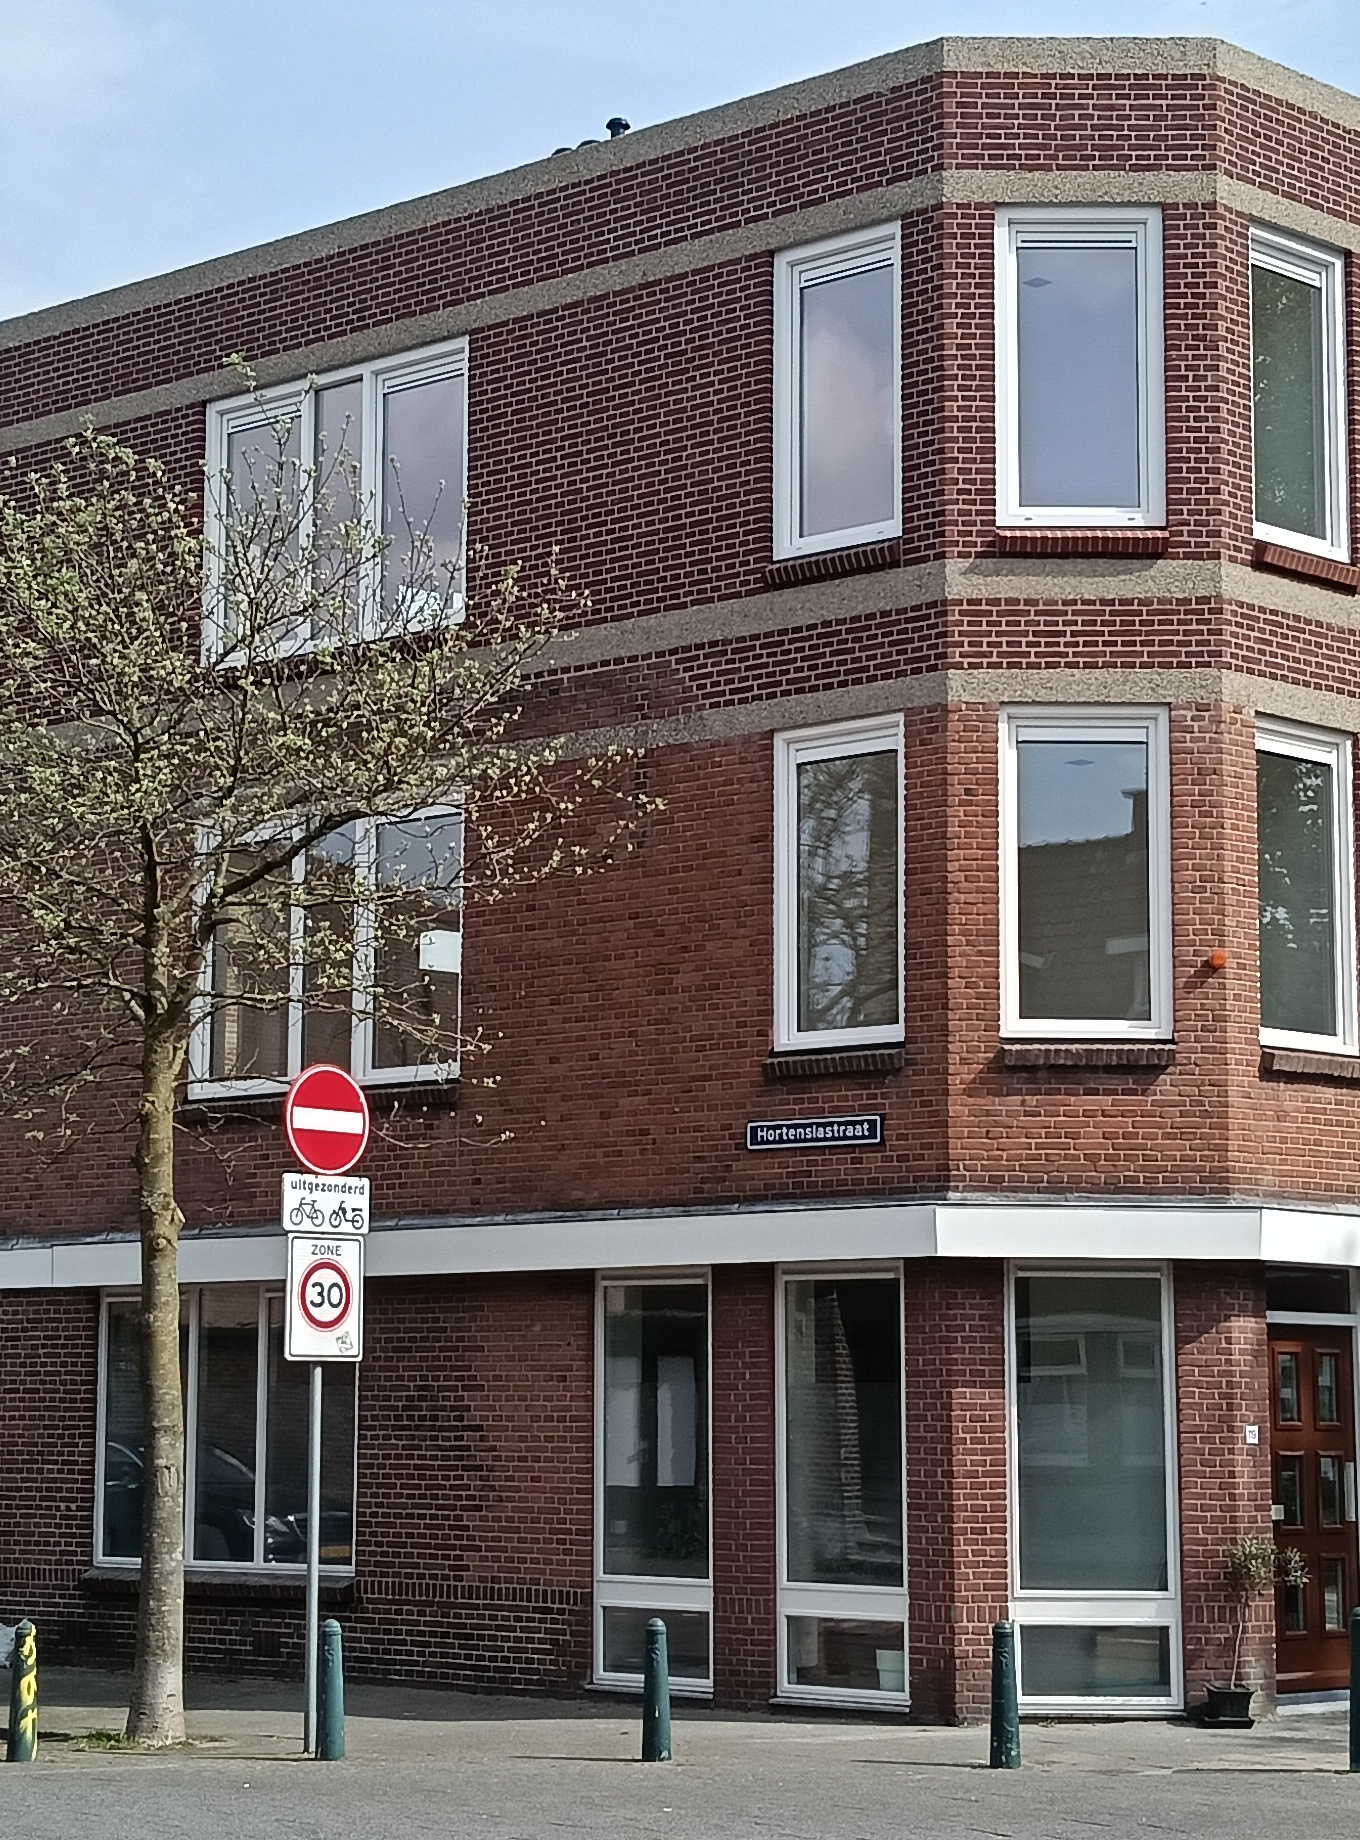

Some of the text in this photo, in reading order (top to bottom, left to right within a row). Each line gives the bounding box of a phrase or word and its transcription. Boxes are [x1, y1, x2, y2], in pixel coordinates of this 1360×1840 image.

[757, 1122, 870, 1142] Hortensiastraat
[290, 1179, 365, 1196] uitgezonderd
[311, 1244, 343, 1256] ZONE
[309, 1281, 344, 1309] 30
